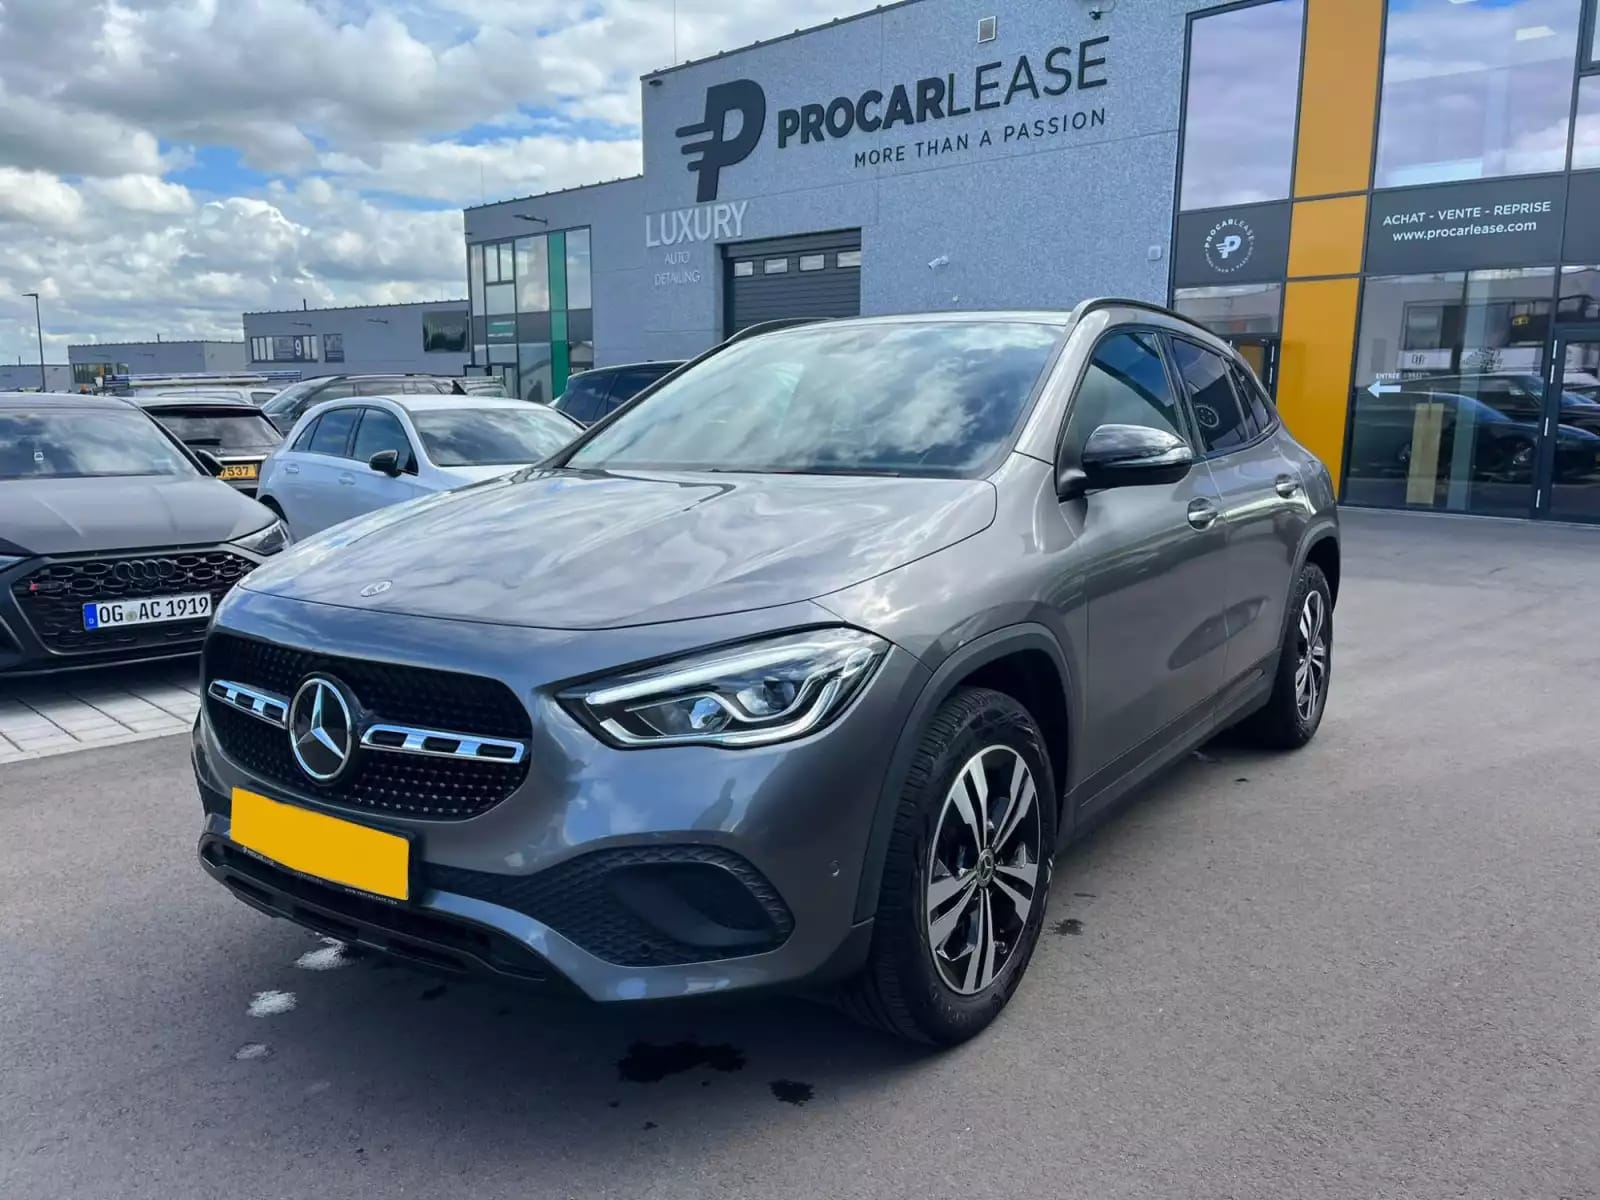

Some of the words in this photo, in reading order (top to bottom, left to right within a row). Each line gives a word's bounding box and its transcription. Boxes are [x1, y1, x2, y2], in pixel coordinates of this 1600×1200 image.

[777, 36, 1110, 149] PROCARLEASE
[854, 145, 906, 168] MORE
[914, 132, 969, 159] THAN
[979, 129, 992, 147] A
[1003, 107, 1106, 143] PASSION
[646, 200, 748, 247] LUXURY
[1382, 211, 1426, 226] ACHAT
[1438, 206, 1482, 221] VENTE
[1494, 200, 1552, 216] REPRISE
[1392, 220, 1537, 241] www.procarlease.com
[664, 251, 690, 265] AUTO
[654, 269, 701, 287] DETAILING
[294, 339, 302, 356] 9
[99, 604, 124, 624] OG
[139, 601, 162, 620] AC
[166, 596, 209, 617] 1919
